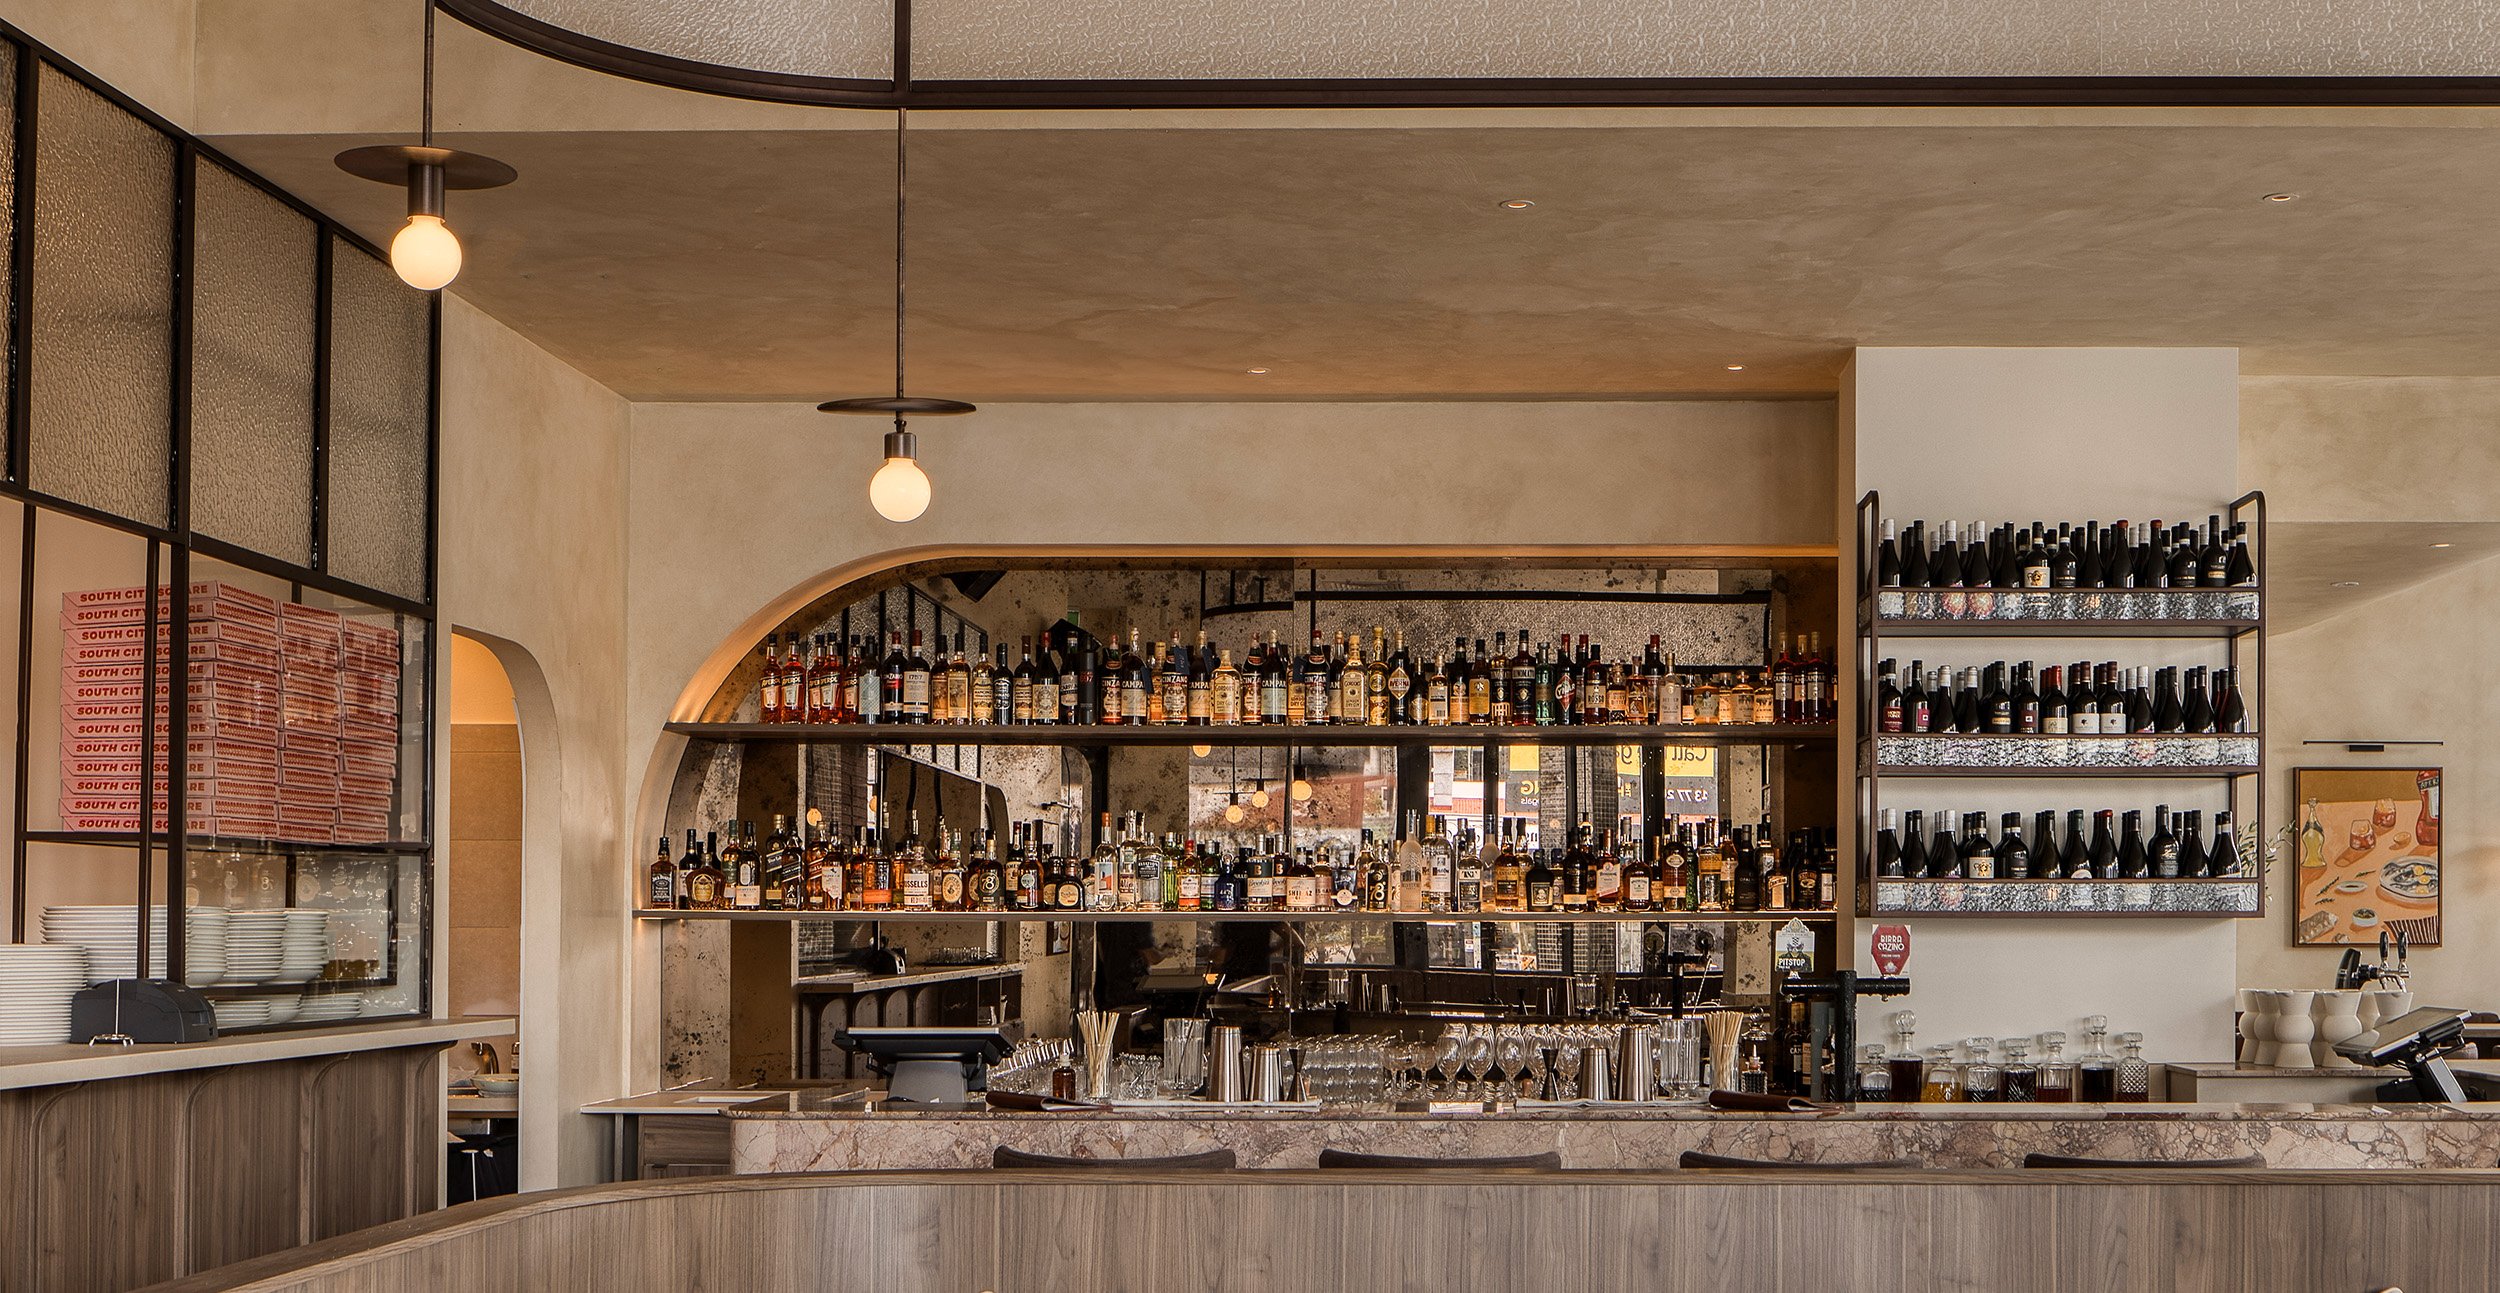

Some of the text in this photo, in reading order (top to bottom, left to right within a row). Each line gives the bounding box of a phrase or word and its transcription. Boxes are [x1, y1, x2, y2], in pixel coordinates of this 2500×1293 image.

[80, 591, 121, 602] SOUTH
[125, 589, 145, 599] CIT
[77, 610, 118, 620] SOUTH
[81, 630, 123, 640] SOUTH
[126, 628, 145, 638] CIT
[79, 649, 120, 659] SOUTH
[123, 648, 143, 657] CIT
[78, 668, 119, 678] SOUTH
[121, 667, 143, 676] CIT
[1304, 675, 1326, 684] CINZAN
[77, 687, 118, 697] SOUTH
[121, 687, 144, 696] CIT
[76, 706, 118, 716] SOUTH
[121, 705, 143, 715] CIT
[77, 725, 120, 734] SOUTH
[122, 724, 142, 733] CIT
[75, 744, 118, 753] SOUTH
[120, 743, 141, 752] CIT
[76, 763, 118, 772] SOUTH
[121, 763, 141, 772] CIT
[76, 782, 119, 791] SOUTH
[122, 782, 141, 791] CIT
[74, 801, 116, 810] SOUTH
[119, 801, 140, 810] CIT
[78, 820, 120, 829] SOUTH
[122, 820, 141, 829] CIT
[1880, 934, 1903, 943] BIRRA
[1877, 942, 1905, 951] CAZINO
[1778, 958, 1806, 967] PITSTOP
